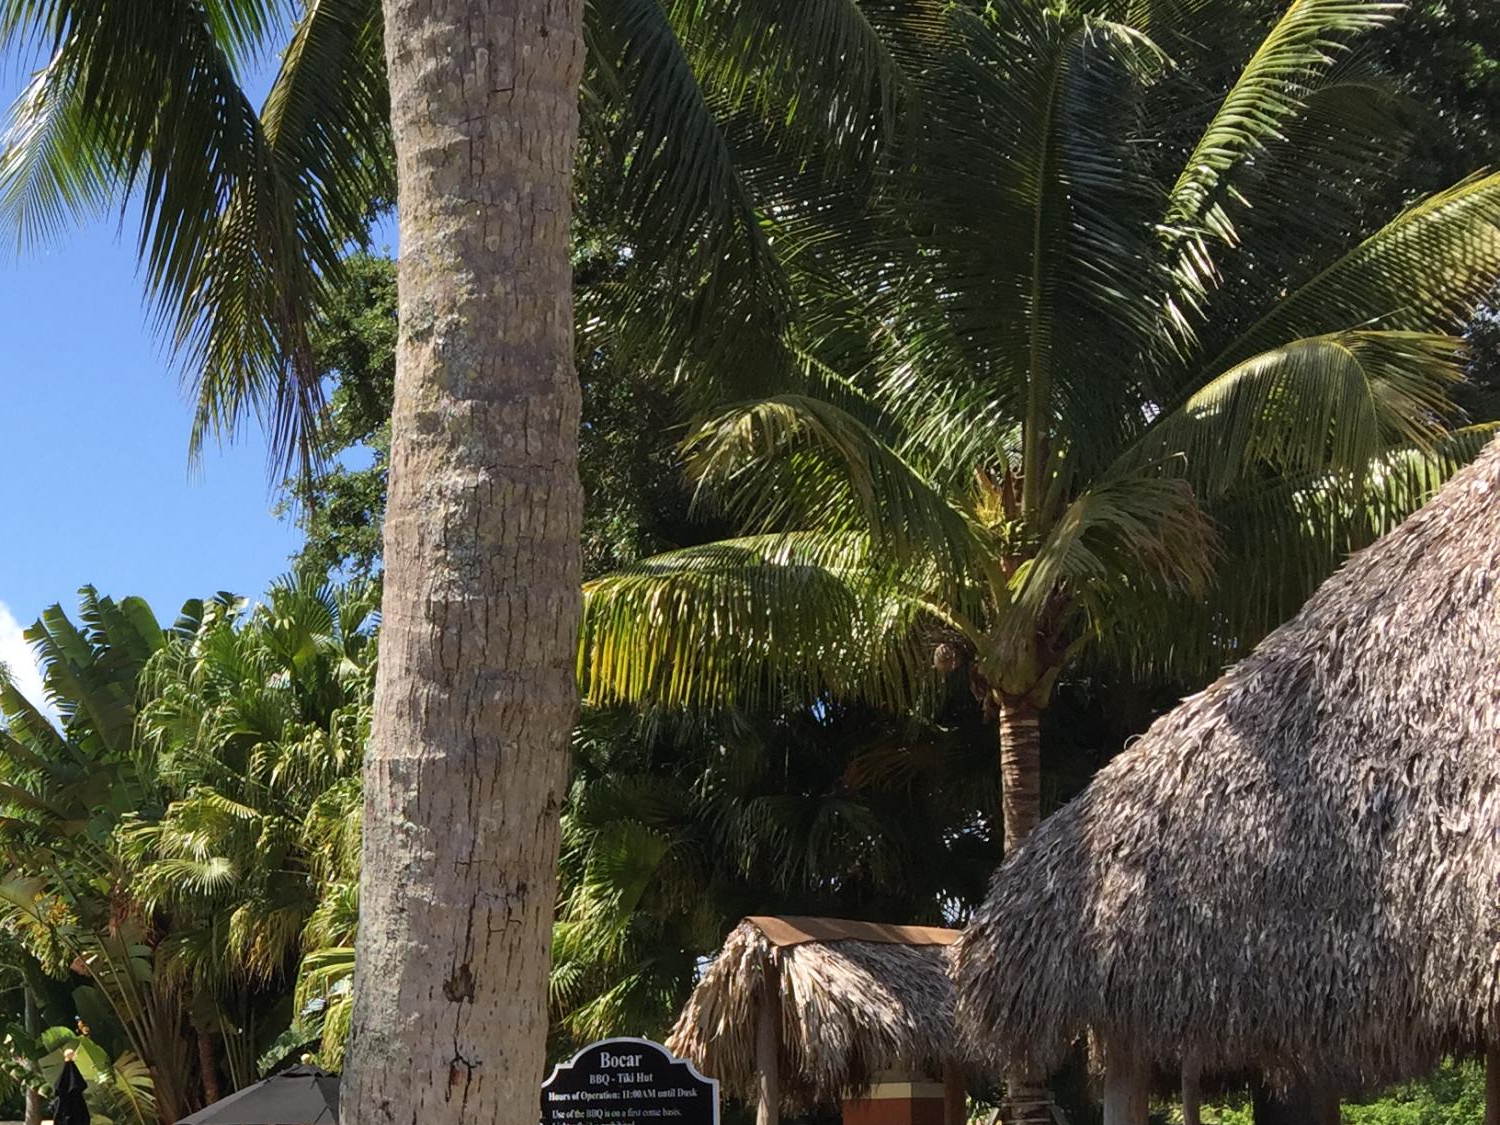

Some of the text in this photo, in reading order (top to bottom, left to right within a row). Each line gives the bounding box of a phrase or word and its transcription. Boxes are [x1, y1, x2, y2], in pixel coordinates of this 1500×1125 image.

[601, 1052, 642, 1068] Bocar
[590, 1074, 609, 1085] BBQ
[617, 1073, 633, 1083] Tiki
[637, 1073, 653, 1082] Hut
[549, 1088, 697, 1102] Hours of Operation: 11:00AM until Dusk
